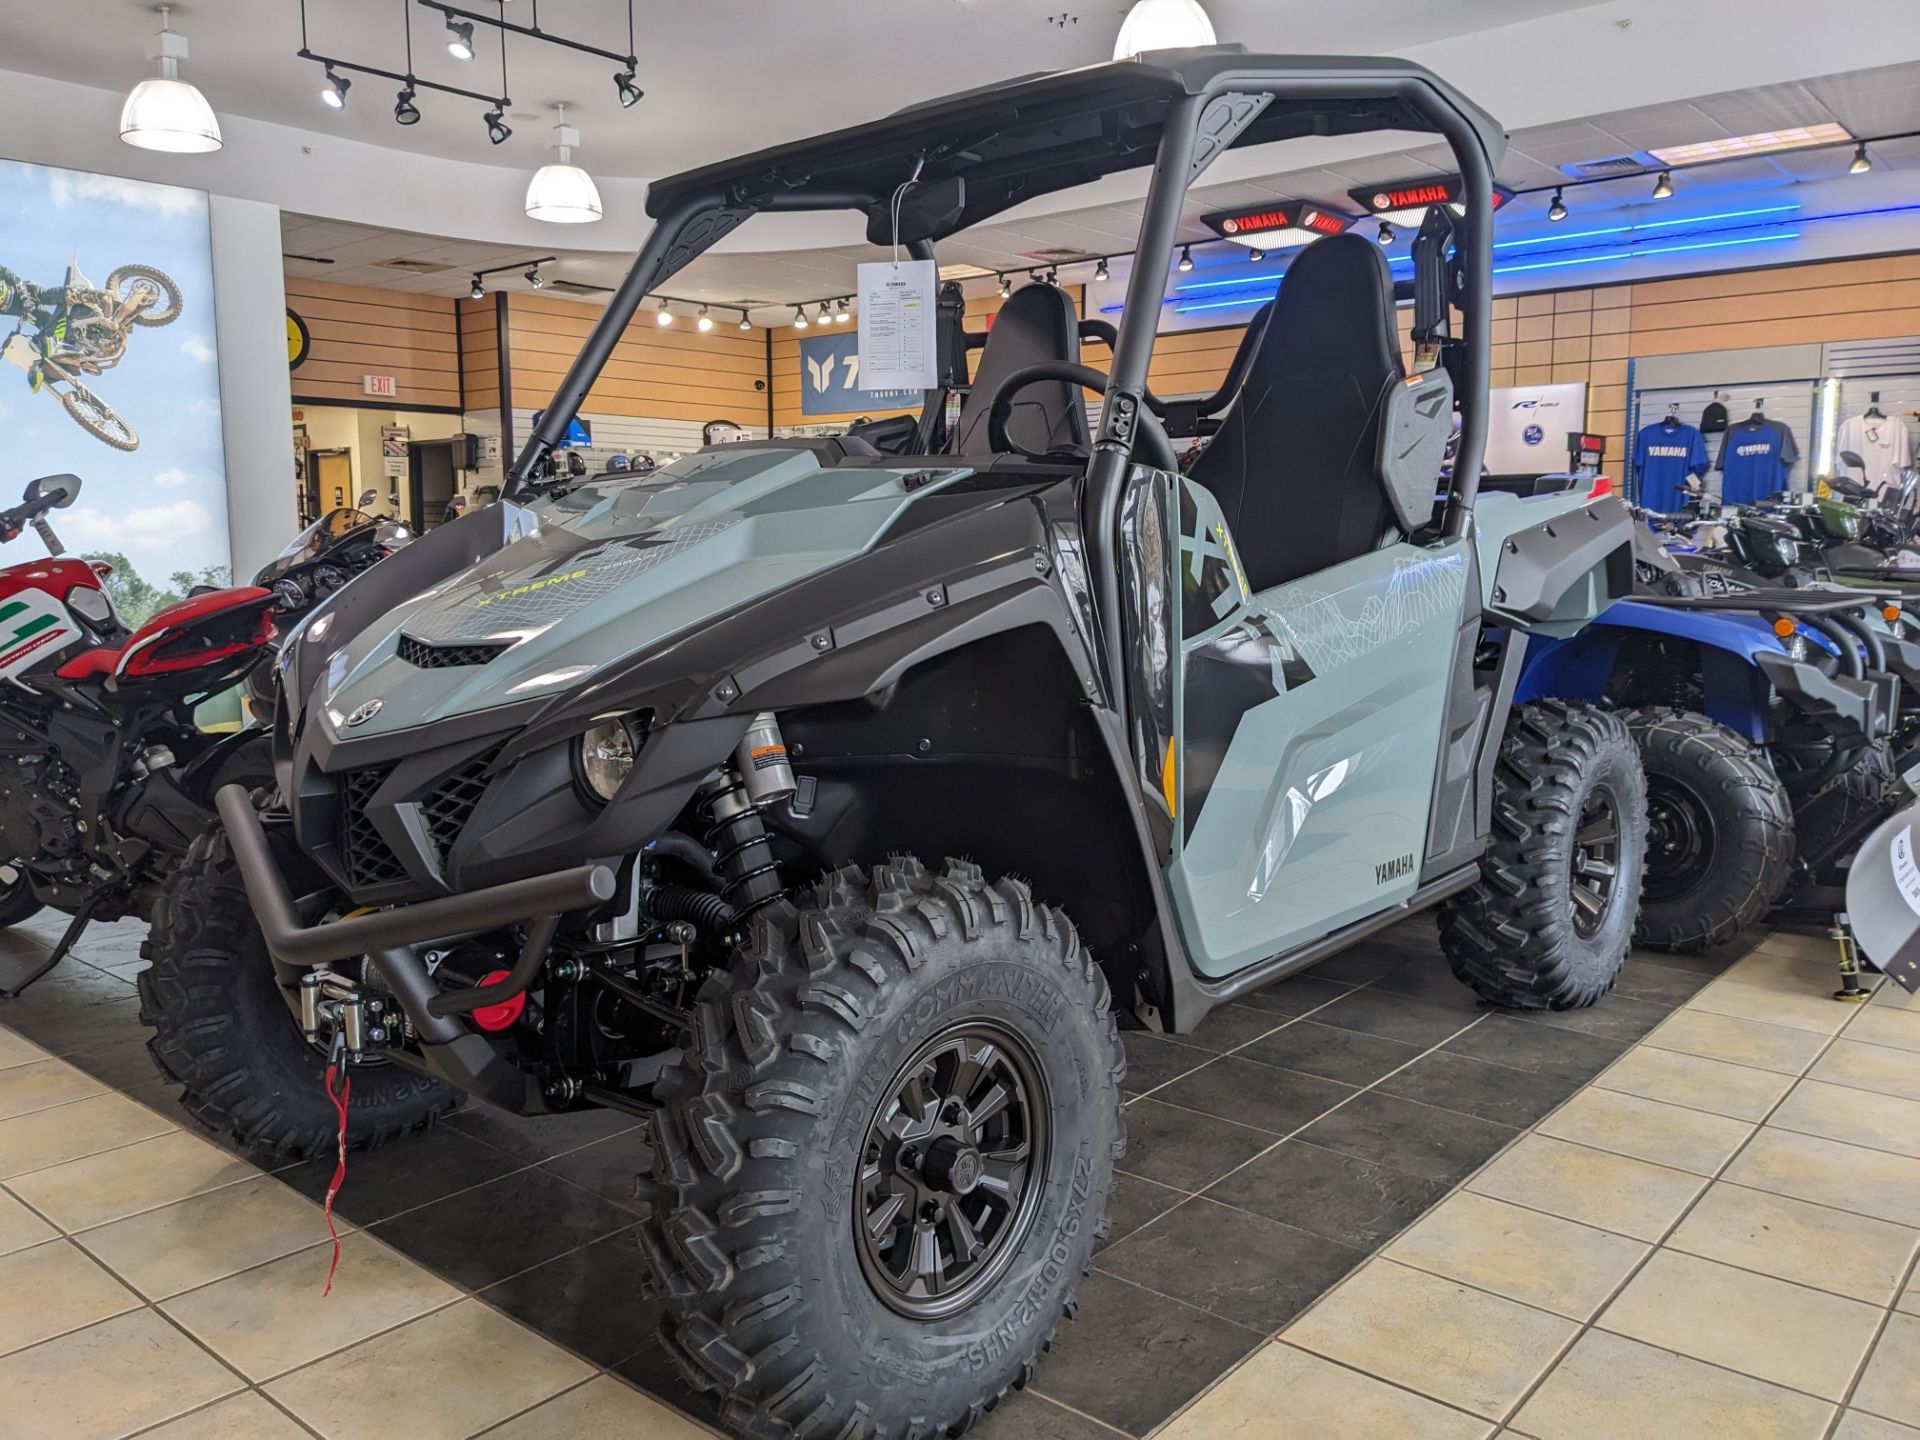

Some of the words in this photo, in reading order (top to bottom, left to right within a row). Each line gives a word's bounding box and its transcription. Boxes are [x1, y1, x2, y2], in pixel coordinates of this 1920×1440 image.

[1388, 185, 1448, 207] YAMAHA
[1236, 211, 1288, 231] YAMAHA
[371, 377, 392, 393] EXIT
[1648, 446, 1687, 458] YAMAHA
[594, 552, 658, 572] TERRAIN
[476, 569, 588, 608] XTREME
[1375, 853, 1414, 885] YAMAHA
[896, 967, 1064, 1044] COMMANDER
